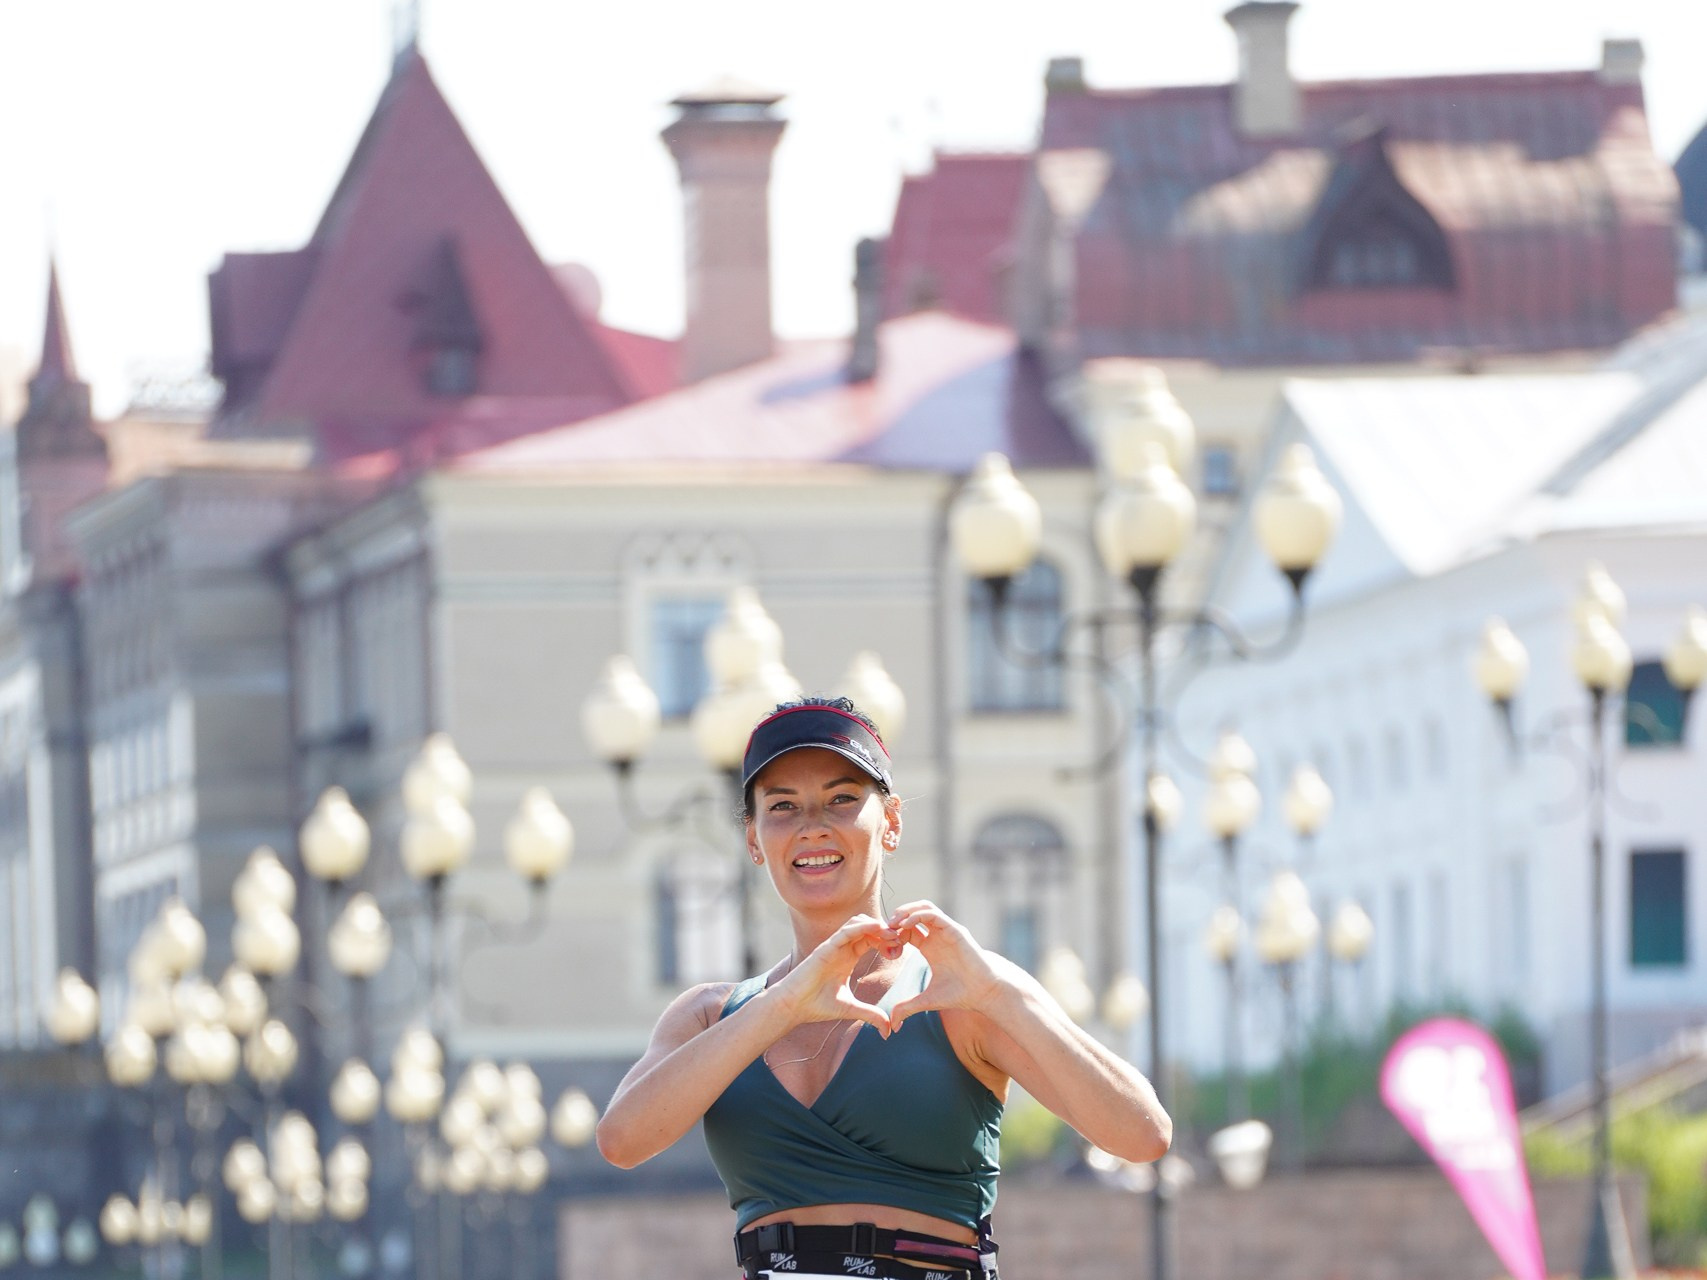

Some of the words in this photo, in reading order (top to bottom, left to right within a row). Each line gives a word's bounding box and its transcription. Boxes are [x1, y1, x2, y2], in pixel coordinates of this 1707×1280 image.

[770, 1253, 786, 1263] RUN
[843, 1256, 864, 1267] RUN
[781, 1261, 797, 1270] LAB
[857, 1265, 876, 1275] LAB
